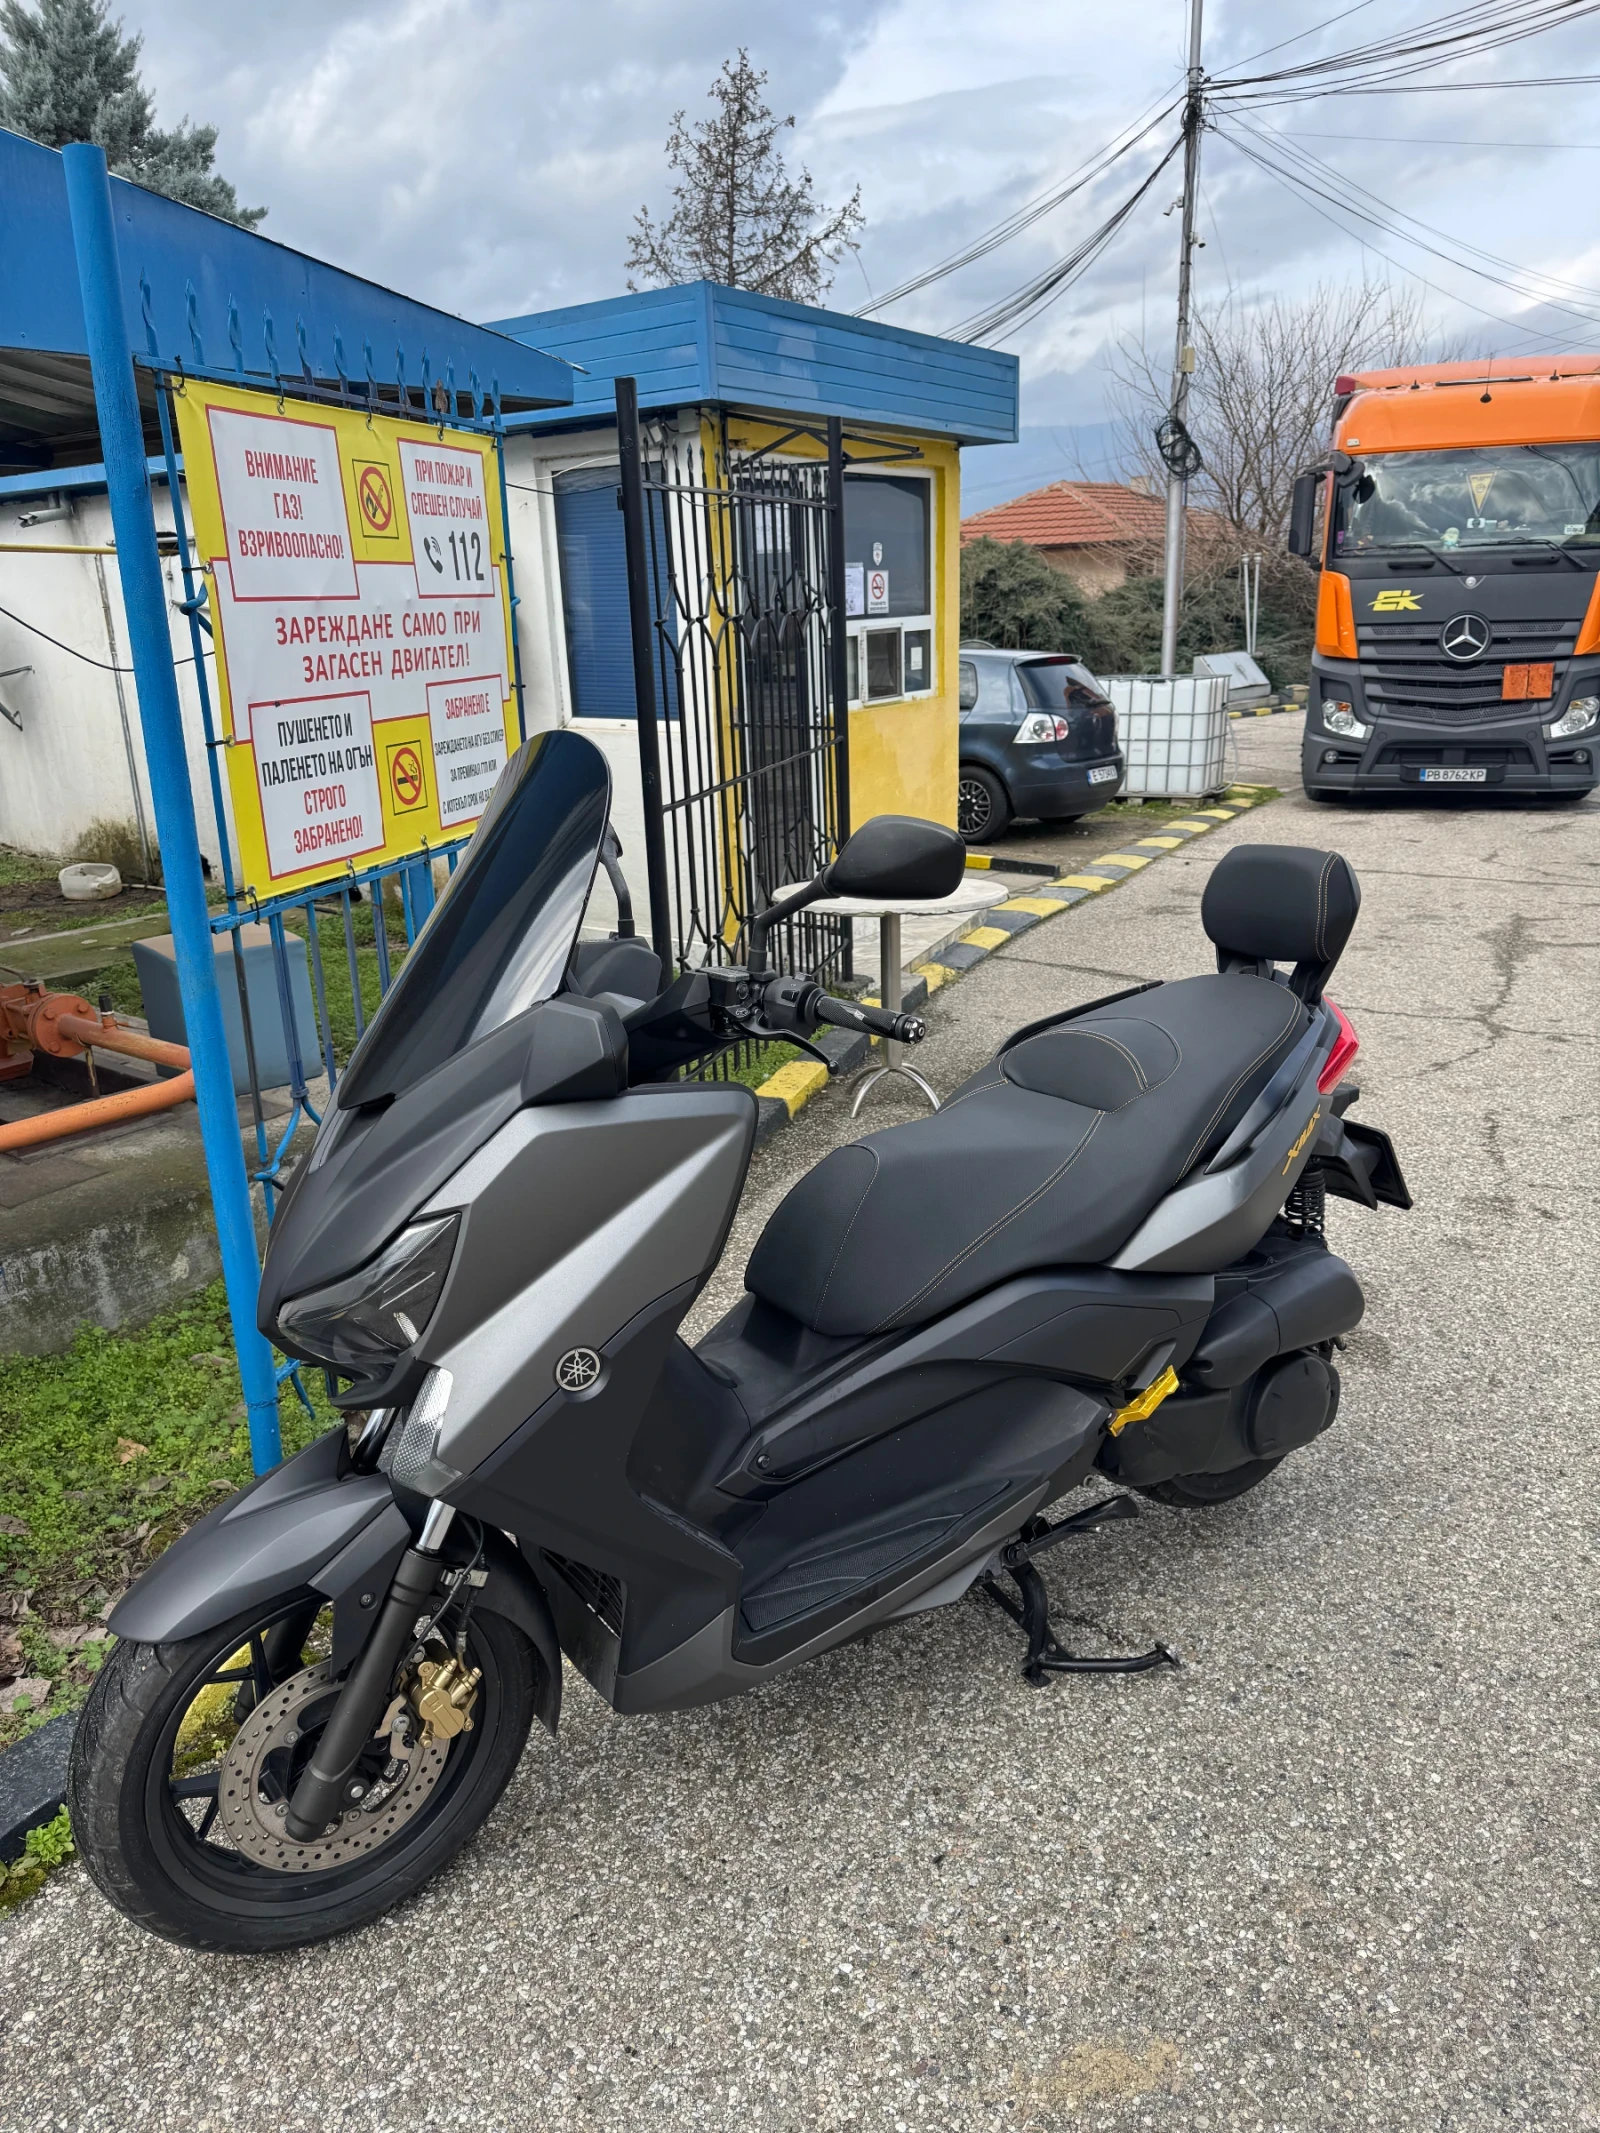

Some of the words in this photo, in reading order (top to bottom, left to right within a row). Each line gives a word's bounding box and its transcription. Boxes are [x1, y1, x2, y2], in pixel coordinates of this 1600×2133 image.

[244, 449, 319, 484] ВНИМАНИЕ
[414, 459, 435, 483] ПРИ
[434, 461, 465, 487] ПОЖАР
[465, 467, 473, 488] И
[273, 492, 304, 521] ГАЗ!
[411, 491, 449, 517] СПЕШЕН
[449, 495, 483, 520] СЛУЧАЙ
[238, 529, 345, 560] ВЗРИВООПАСНО!
[448, 530, 485, 581] 112
[274, 613, 394, 648] ЗАРЕЖДАНЕ
[402, 611, 447, 638] САМО
[453, 610, 481, 635] ПРИ
[302, 650, 383, 684] ЗАГАСЕН
[391, 642, 471, 680] ДВИГАТЕЛ!
[444, 692, 486, 720] ЗАБРАНЕНО
[485, 692, 491, 713] Е
[277, 714, 343, 747] ПУШЕНЕТО
[343, 712, 354, 737] И
[434, 736, 468, 756] ЗАРЕЖДАНЕТО
[261, 752, 327, 788] ПАЛЕНЕТО
[327, 749, 345, 774] НА
[345, 744, 374, 771] ОГЪН
[450, 768, 457, 782] ЗА
[1426, 770, 1441, 780] PB
[1442, 770, 1469, 780] 8762
[303, 784, 347, 815] СТРОГО
[293, 815, 364, 854] ЗАБРАНЕНО!
